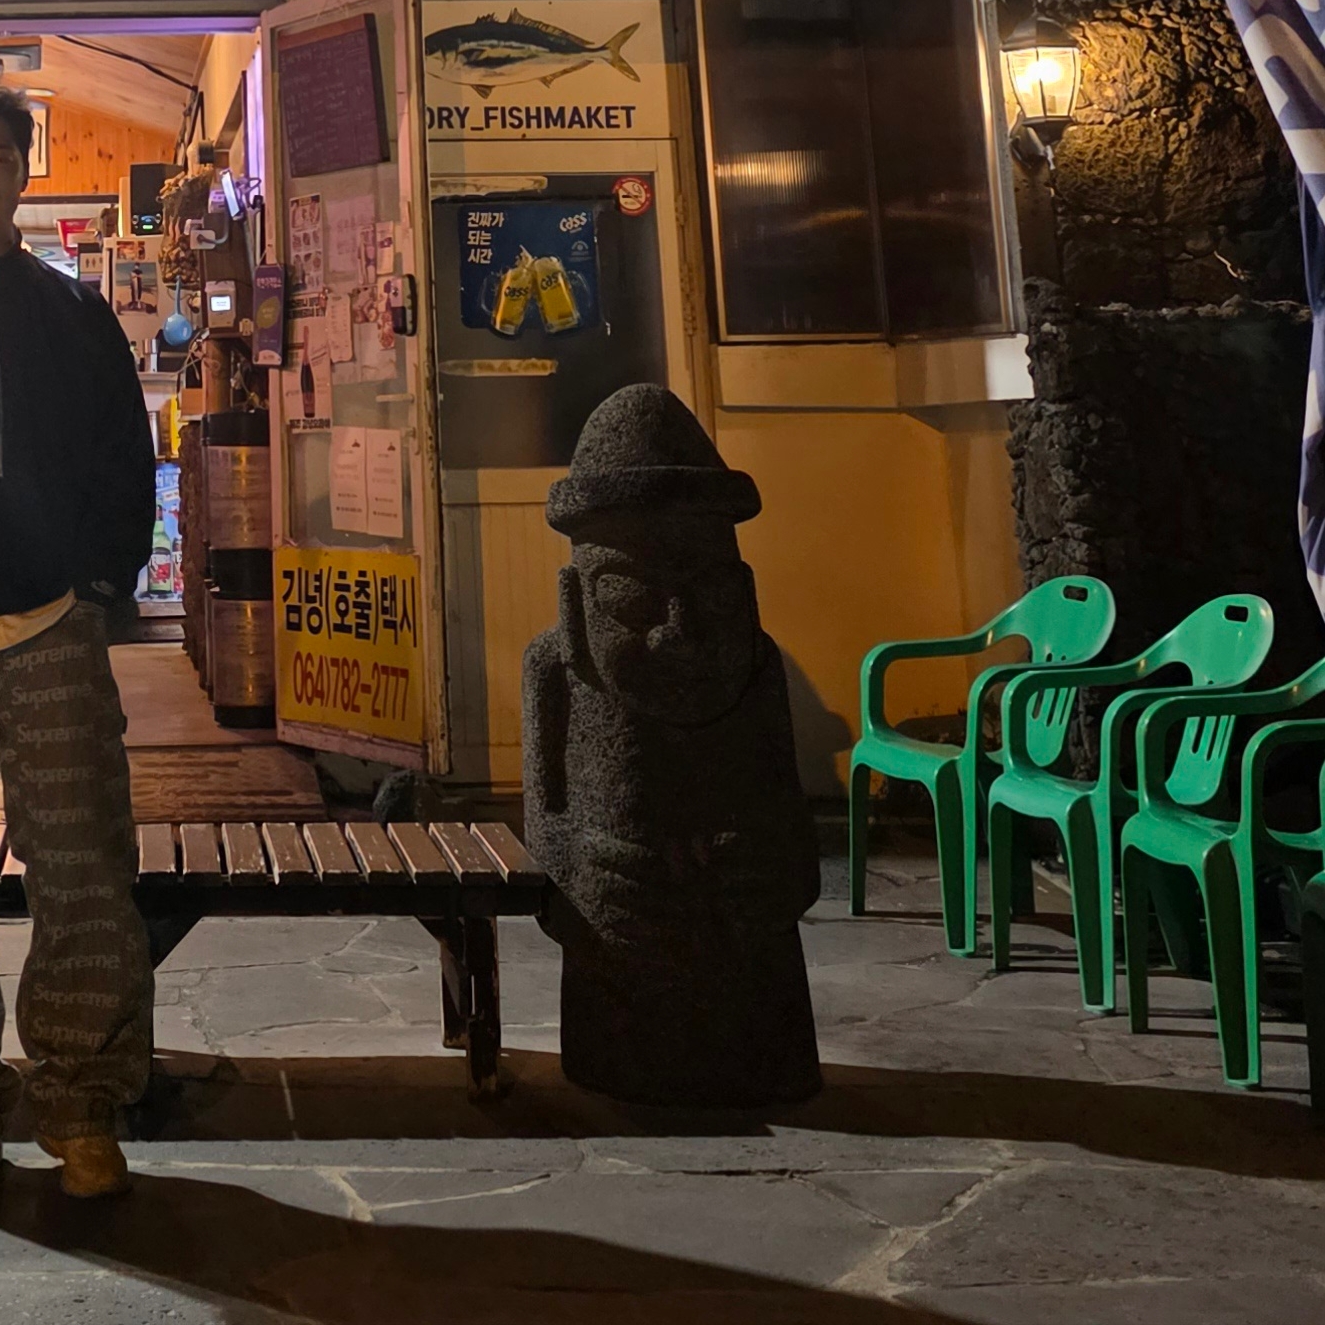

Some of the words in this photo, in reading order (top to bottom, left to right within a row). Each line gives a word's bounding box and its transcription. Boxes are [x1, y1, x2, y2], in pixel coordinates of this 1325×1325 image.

[467, 212, 505, 228] 진짜가
[467, 231, 492, 246] 되는
[468, 249, 493, 264] 시간
[540, 272, 559, 291] Cas
[282, 566, 417, 648] 김녕(호출)택시
[11, 682, 93, 710] Supreme
[293, 651, 409, 721] 064)782-2777
[17, 722, 95, 749] Supreme
[19, 762, 96, 789] Supreme
[31, 1016, 107, 1047] Suprem
